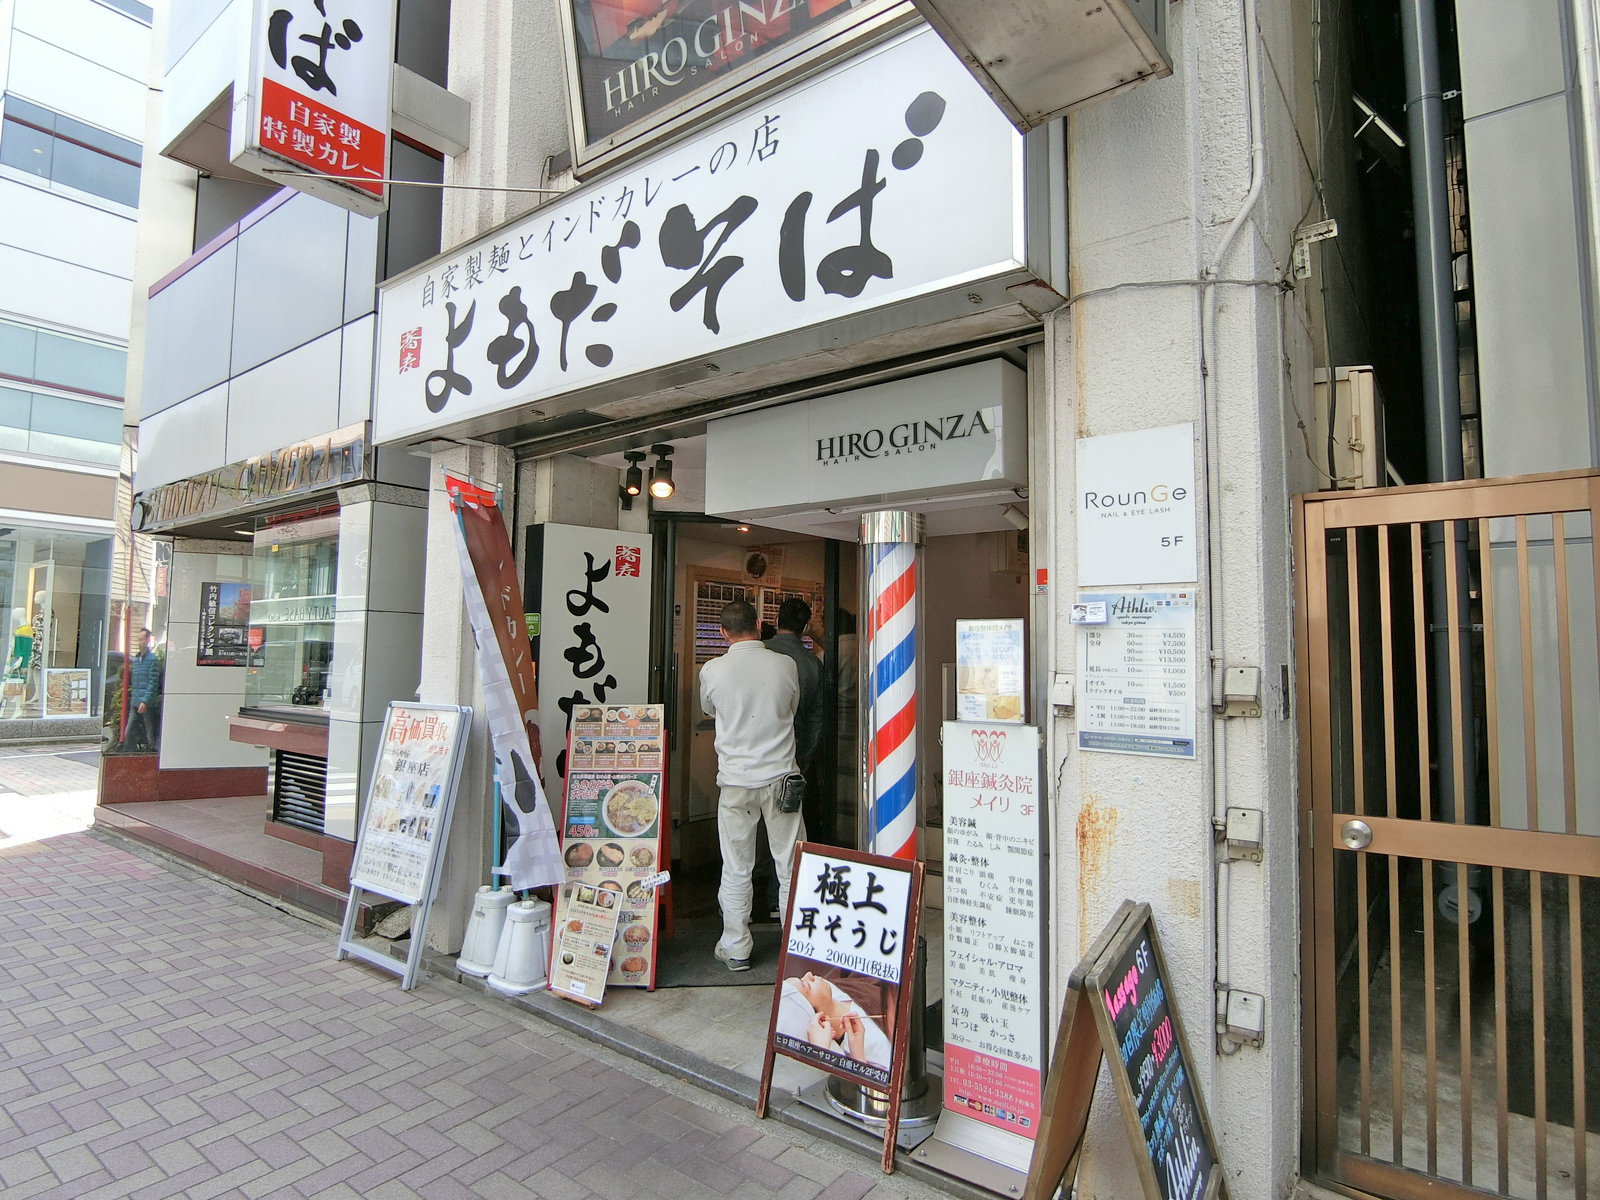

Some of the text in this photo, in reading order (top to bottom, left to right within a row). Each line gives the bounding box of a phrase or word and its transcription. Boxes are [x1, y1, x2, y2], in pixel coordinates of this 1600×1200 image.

[267, 0, 363, 96] ば
[602, 0, 806, 113] HIRO GINZ
[614, 33, 758, 117] HAIR SALON
[288, 100, 362, 151] 自家製
[261, 115, 382, 180] 特製カレー
[421, 115, 781, 308] 自家製麺とインドカレーの店
[425, 91, 947, 414] よもだそば
[816, 410, 991, 461] HIRO GINZA
[823, 443, 936, 467] HAIR SALON
[148, 438, 332, 524] SHIMIZU CAMERA
[1084, 484, 1187, 510] RounGe
[1100, 511, 1121, 519] NAIL
[1131, 508, 1147, 516] EYE
[1149, 506, 1171, 515] LASH
[1160, 536, 1184, 548] 5F
[205, 585, 219, 656] 竹内敏信コレクション展
[388, 710, 449, 746] 高価買取
[394, 758, 430, 778] 銀座店
[948, 768, 1033, 795] 銀座鍼灸院
[969, 794, 1035, 816] メイリ 3F
[947, 827, 979, 838] 顔のゆがみ
[949, 815, 977, 829] 美容鍼
[967, 840, 984, 849] たるみ
[989, 843, 1001, 851] しみ
[813, 862, 888, 915] 極上
[947, 875, 1034, 898] 腰痛 むくみ 生理痛
[979, 870, 995, 880] 頭痛
[1008, 875, 1033, 887] 背中痛
[947, 885, 1034, 908] うつ病 不安症 更年期
[947, 895, 1035, 919] 自律神経失調症 睡眠障害
[795, 907, 898, 956] 耳そうじ
[951, 911, 988, 928] 美容整体
[948, 925, 1035, 950] 小顔 リフトアップ ねこ背
[948, 933, 979, 947] 骨盤矯正
[788, 937, 900, 983] 20分 2000円(税抜)
[950, 960, 966, 970] 美顔
[979, 967, 996, 978] 美肌
[1135, 940, 1149, 974] 6F
[949, 988, 1031, 1016] 不妊 妊娠中 産後ケア
[950, 1004, 1009, 1029] 気功 吸い玉
[989, 1028, 1016, 1043] かっさ
[775, 1035, 839, 1065] ヒロ銀座ヘアーサロン
[979, 1041, 1033, 1064] お得な回数券あり
[950, 1065, 966, 1075] 土日祝
[974, 1054, 1009, 1072] 診療時間
[962, 1078, 1014, 1101] 03-5524-3388
